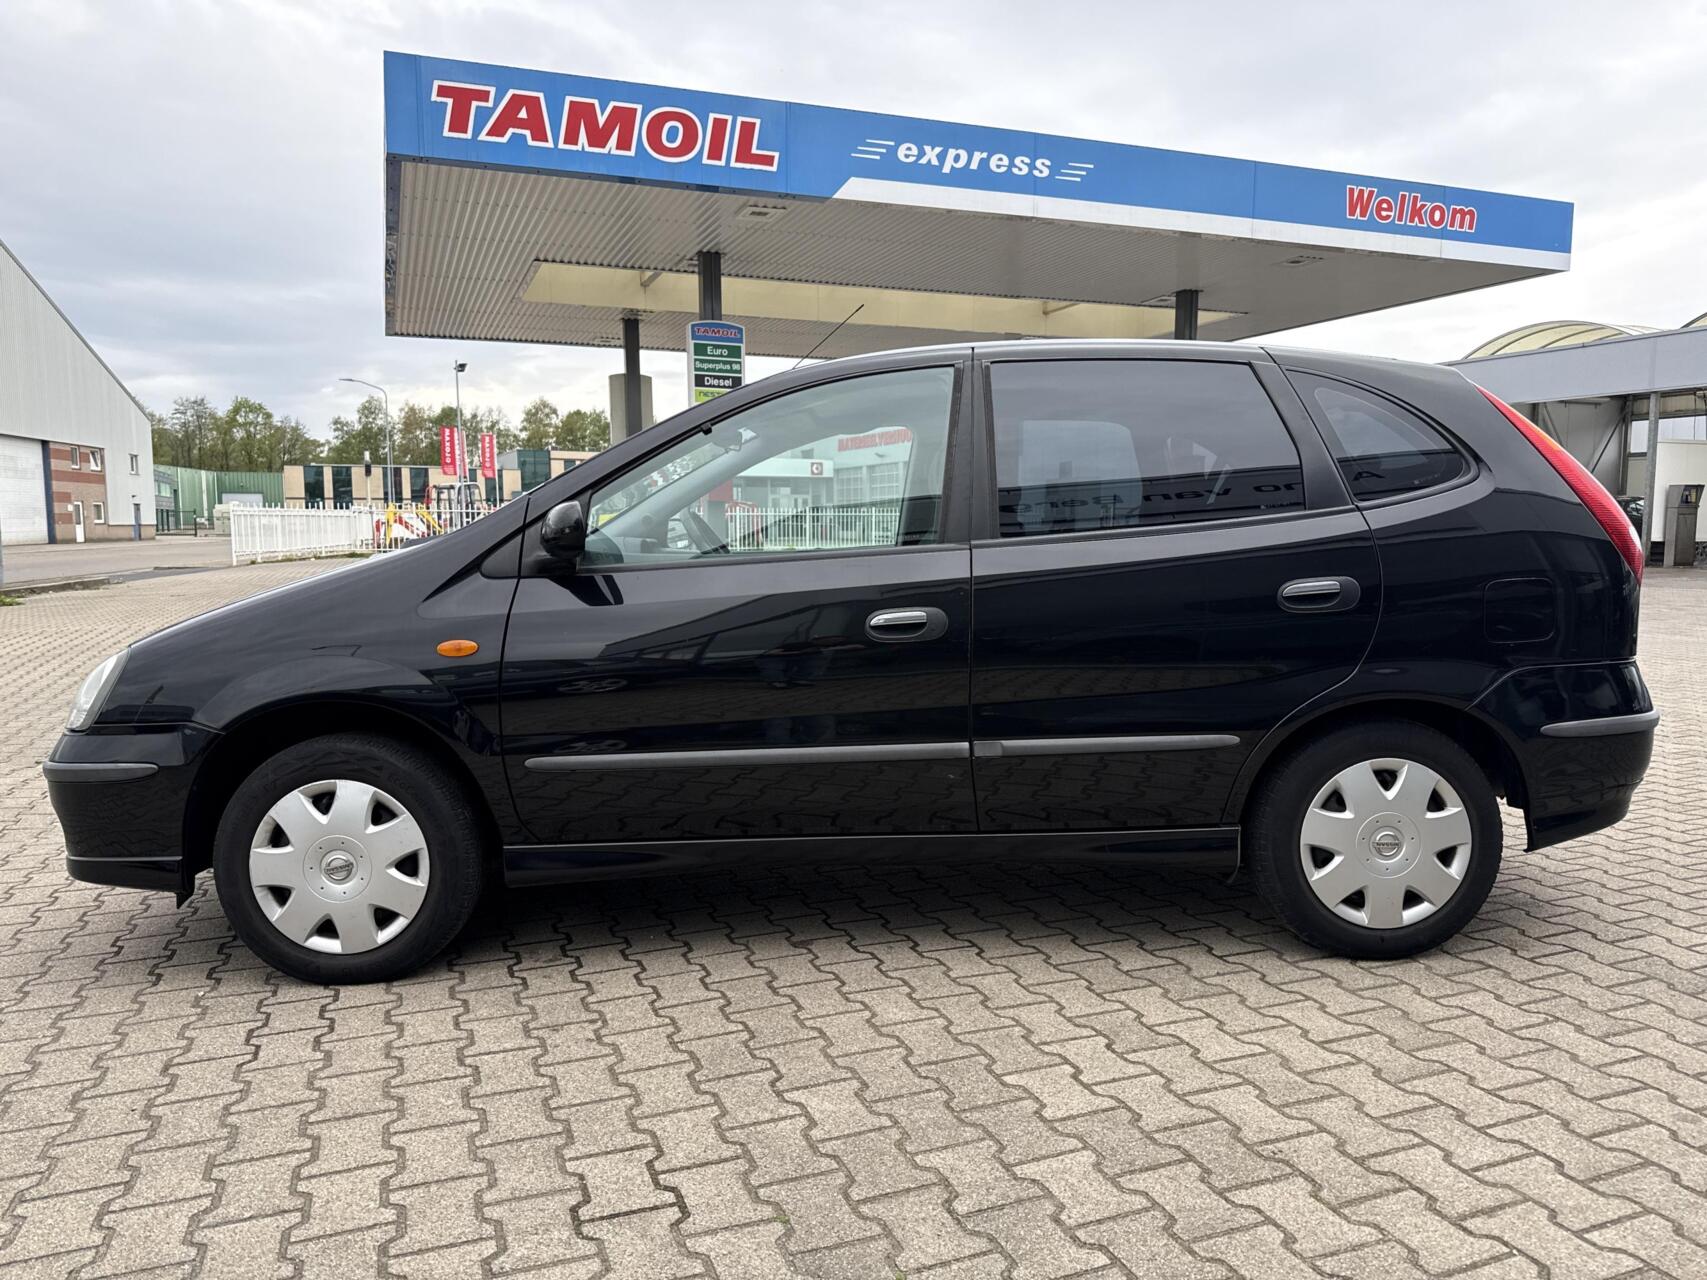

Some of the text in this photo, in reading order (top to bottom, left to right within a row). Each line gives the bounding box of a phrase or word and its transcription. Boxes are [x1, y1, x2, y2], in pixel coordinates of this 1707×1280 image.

[430, 79, 780, 172] TAMOIL
[897, 142, 1052, 178] express
[1346, 184, 1478, 233] Welkom
[695, 327, 739, 338] TAMOIL
[707, 346, 728, 356] Euro
[695, 361, 730, 370] Superplus
[704, 376, 732, 387] Diesel
